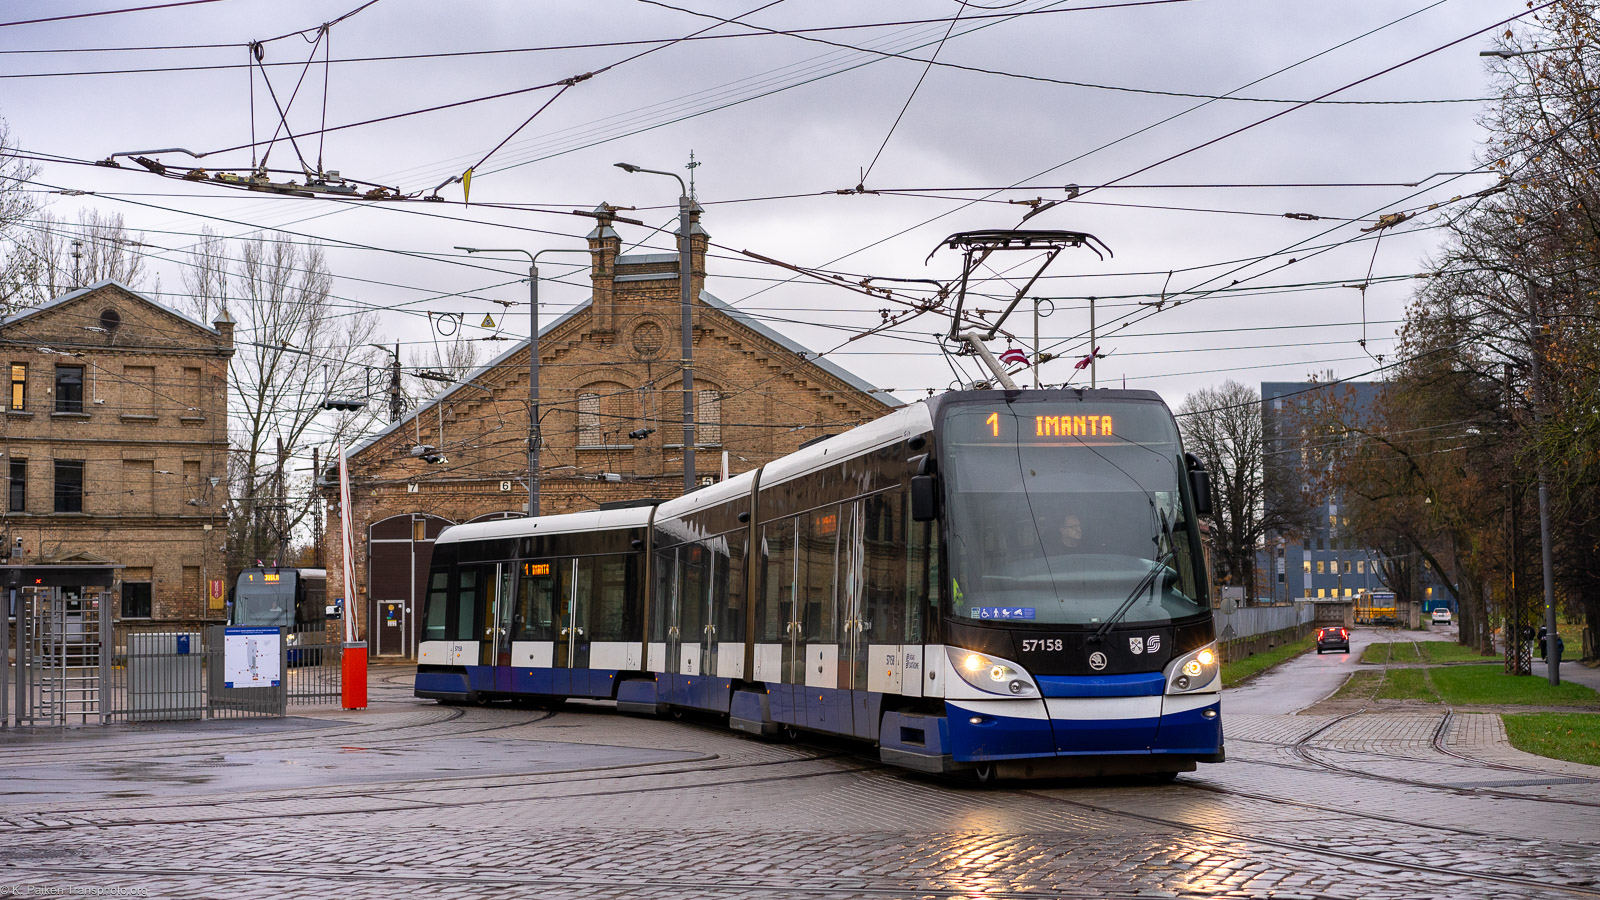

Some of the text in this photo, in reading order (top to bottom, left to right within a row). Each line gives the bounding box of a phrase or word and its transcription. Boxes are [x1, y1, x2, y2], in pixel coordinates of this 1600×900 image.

[986, 412, 1112, 437] 1 IMANTA
[524, 563, 529, 576] 1
[248, 574, 254, 582] 1
[1022, 639, 1063, 652] 57158
